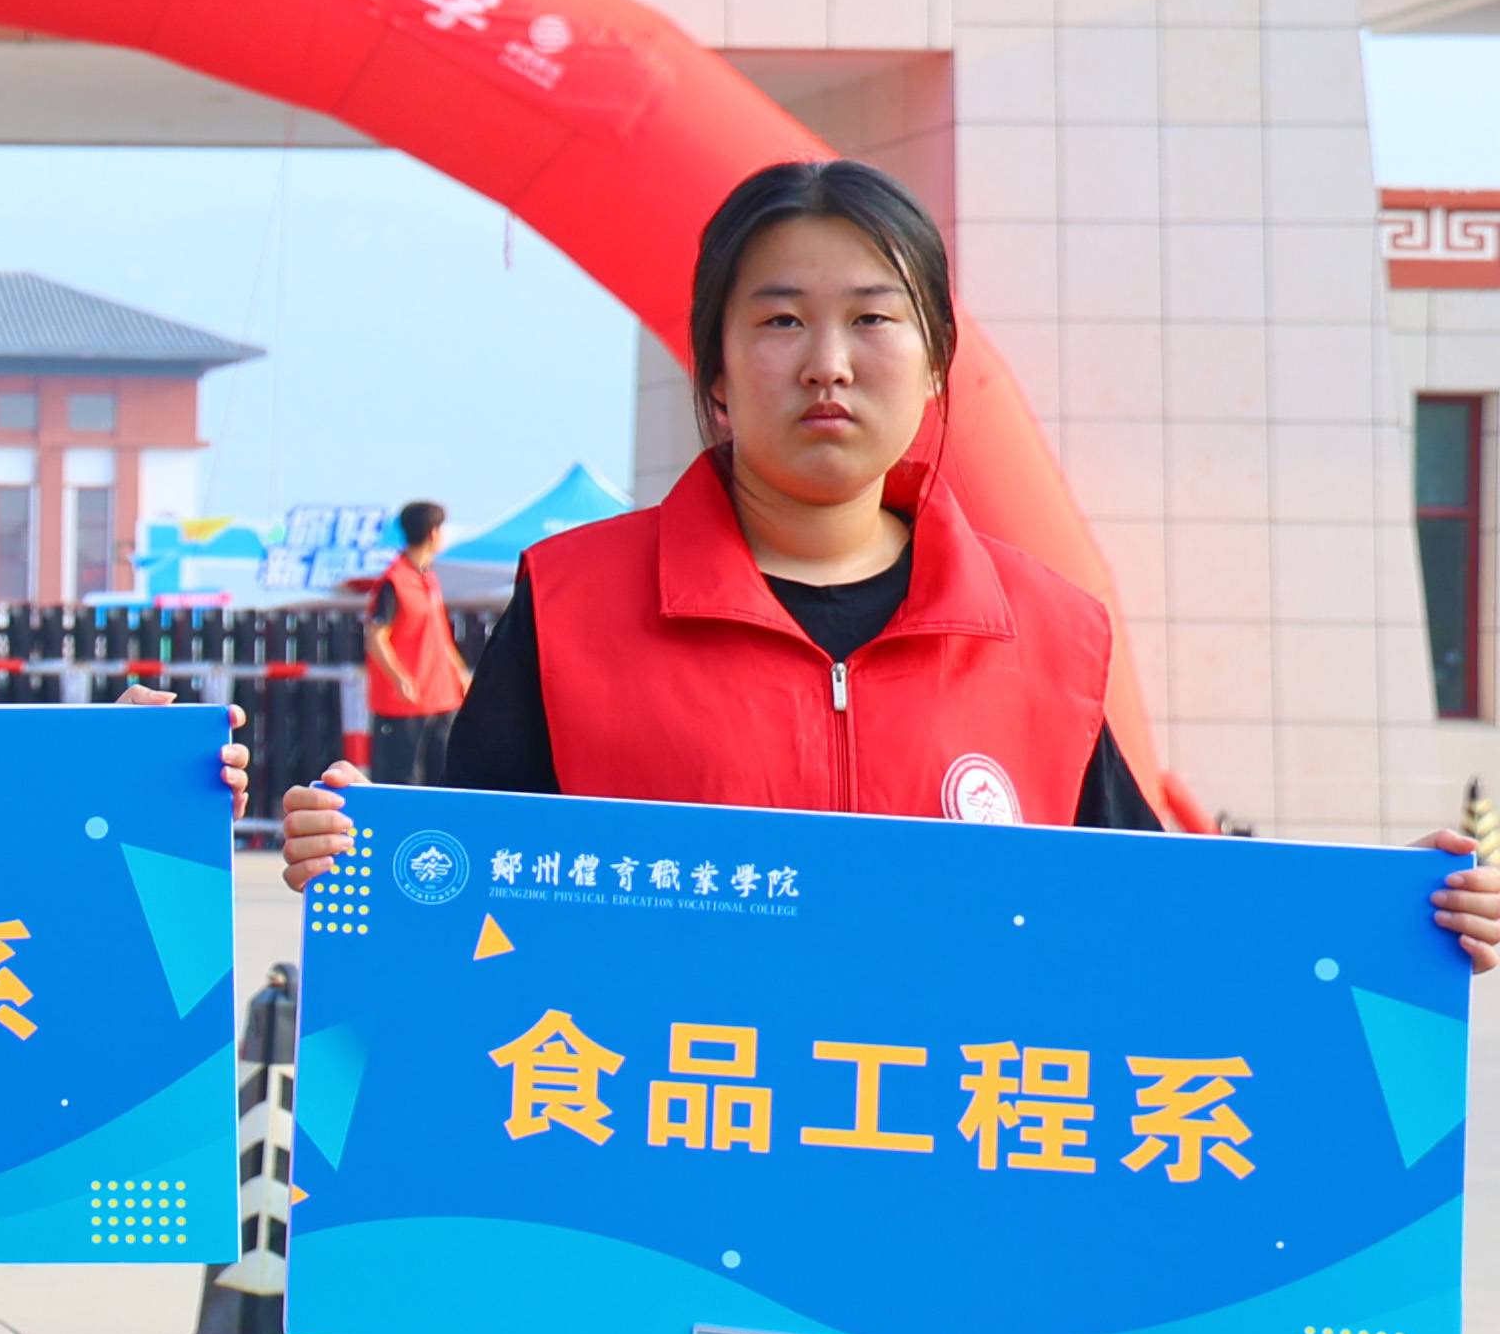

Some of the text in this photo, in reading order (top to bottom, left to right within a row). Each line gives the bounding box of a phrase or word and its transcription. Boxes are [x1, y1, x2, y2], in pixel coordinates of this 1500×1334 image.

[490, 848, 799, 899] 鄭州體育職業學院
[489, 886, 798, 917] ZHENGZHOU PHYSICAL EDUCATION VOCATIONAL COLLEGE
[488, 1008, 1256, 1183] 食品工程系
